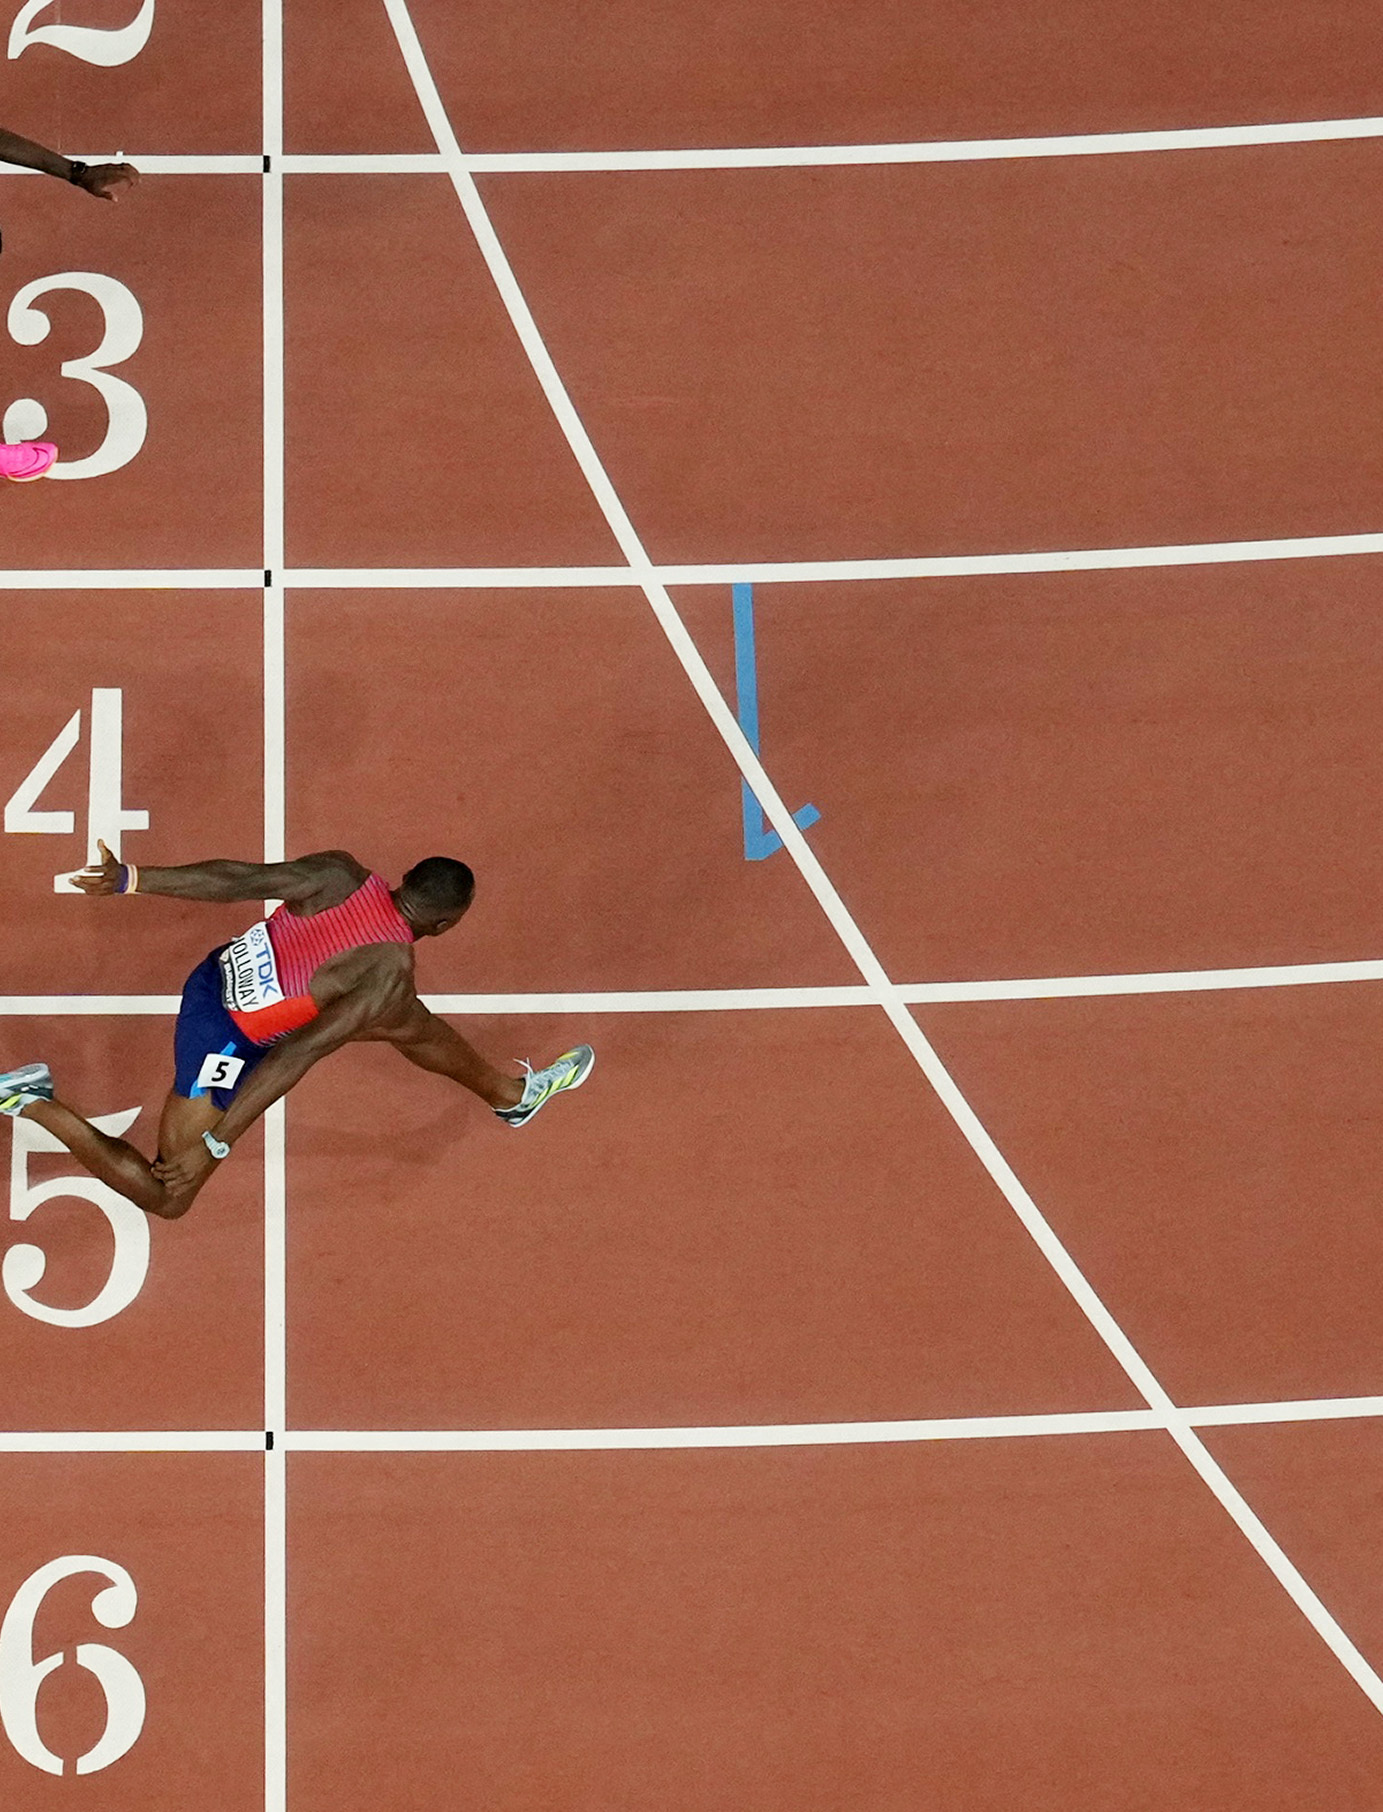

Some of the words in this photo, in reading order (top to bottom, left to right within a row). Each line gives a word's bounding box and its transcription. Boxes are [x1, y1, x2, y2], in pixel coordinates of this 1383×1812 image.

[3, 273, 147, 480] 3
[4, 689, 149, 894] 4
[211, 1061, 229, 1080] 5
[257, 943, 278, 998] TDK
[2, 1106, 150, 1328] 5
